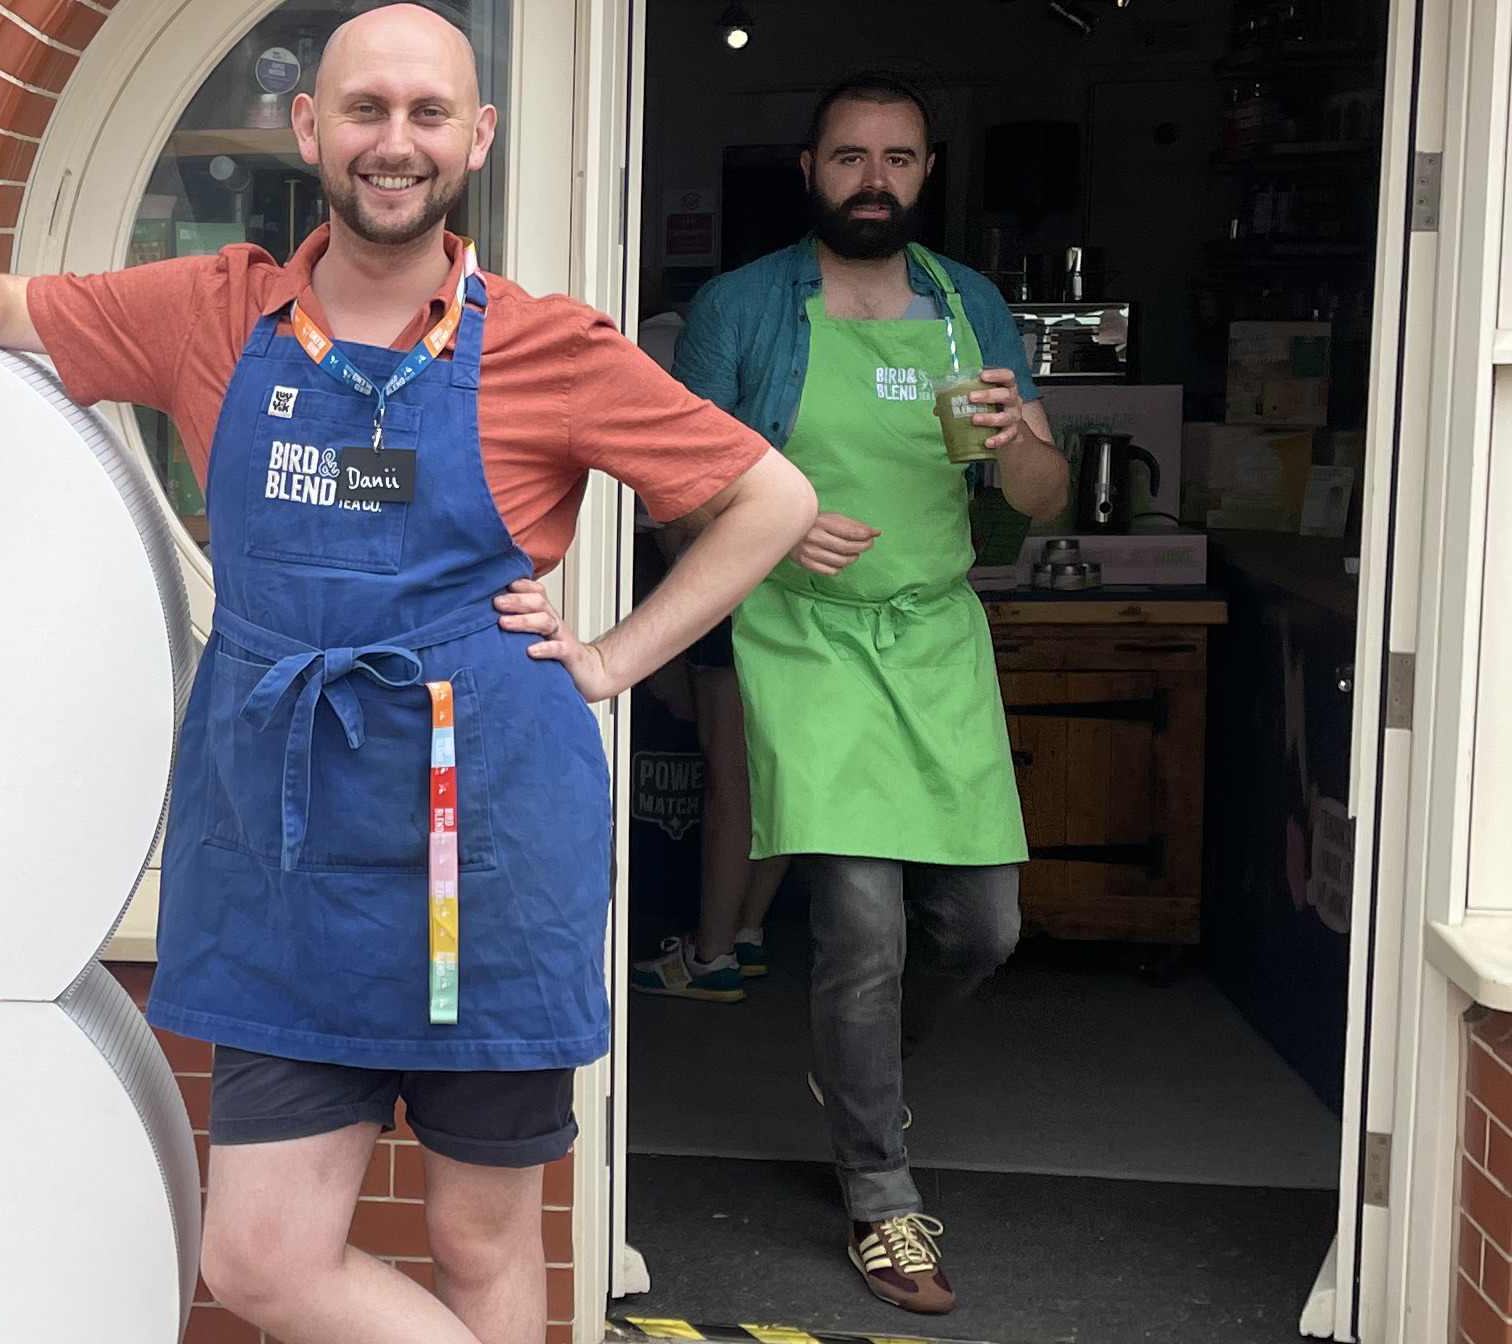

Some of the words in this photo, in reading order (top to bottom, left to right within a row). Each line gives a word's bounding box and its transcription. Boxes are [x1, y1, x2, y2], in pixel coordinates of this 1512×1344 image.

[876, 383, 918, 401] BLEND
[264, 470, 337, 506] BLEND
[346, 466, 400, 490] Danii
[639, 759, 705, 791] POWE
[639, 792, 701, 815] MATCH
